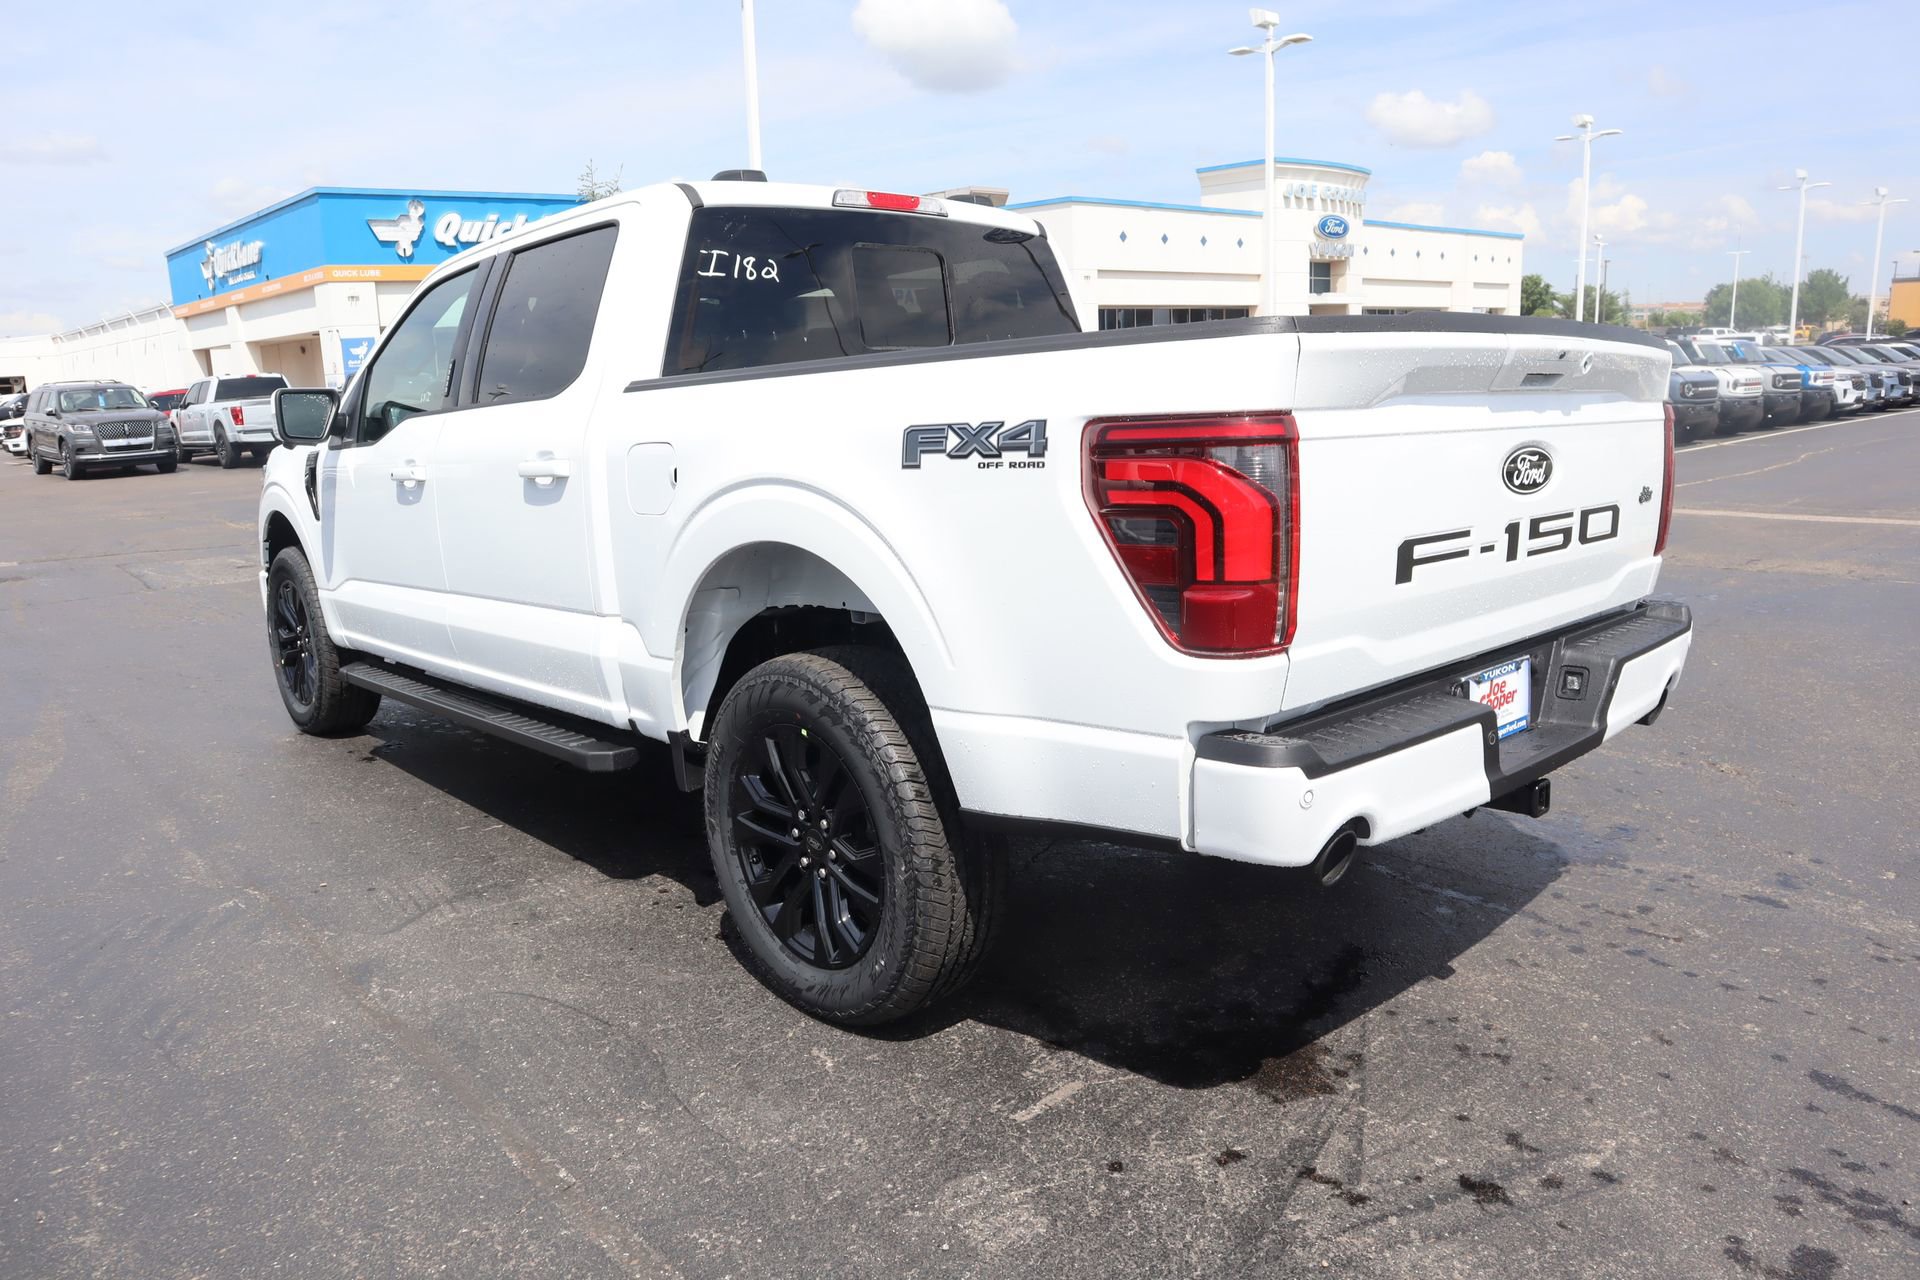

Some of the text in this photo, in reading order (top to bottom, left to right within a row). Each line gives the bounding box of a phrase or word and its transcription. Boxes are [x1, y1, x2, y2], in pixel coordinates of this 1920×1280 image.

[1324, 219, 1345, 234] Ford
[902, 419, 1048, 469] FX4
[977, 461, 1046, 469] OFF ROAD
[1513, 454, 1547, 486] Ford
[1395, 504, 1620, 585] F-150
[1483, 662, 1516, 680] YUKON
[1486, 679, 1507, 699] Joe
